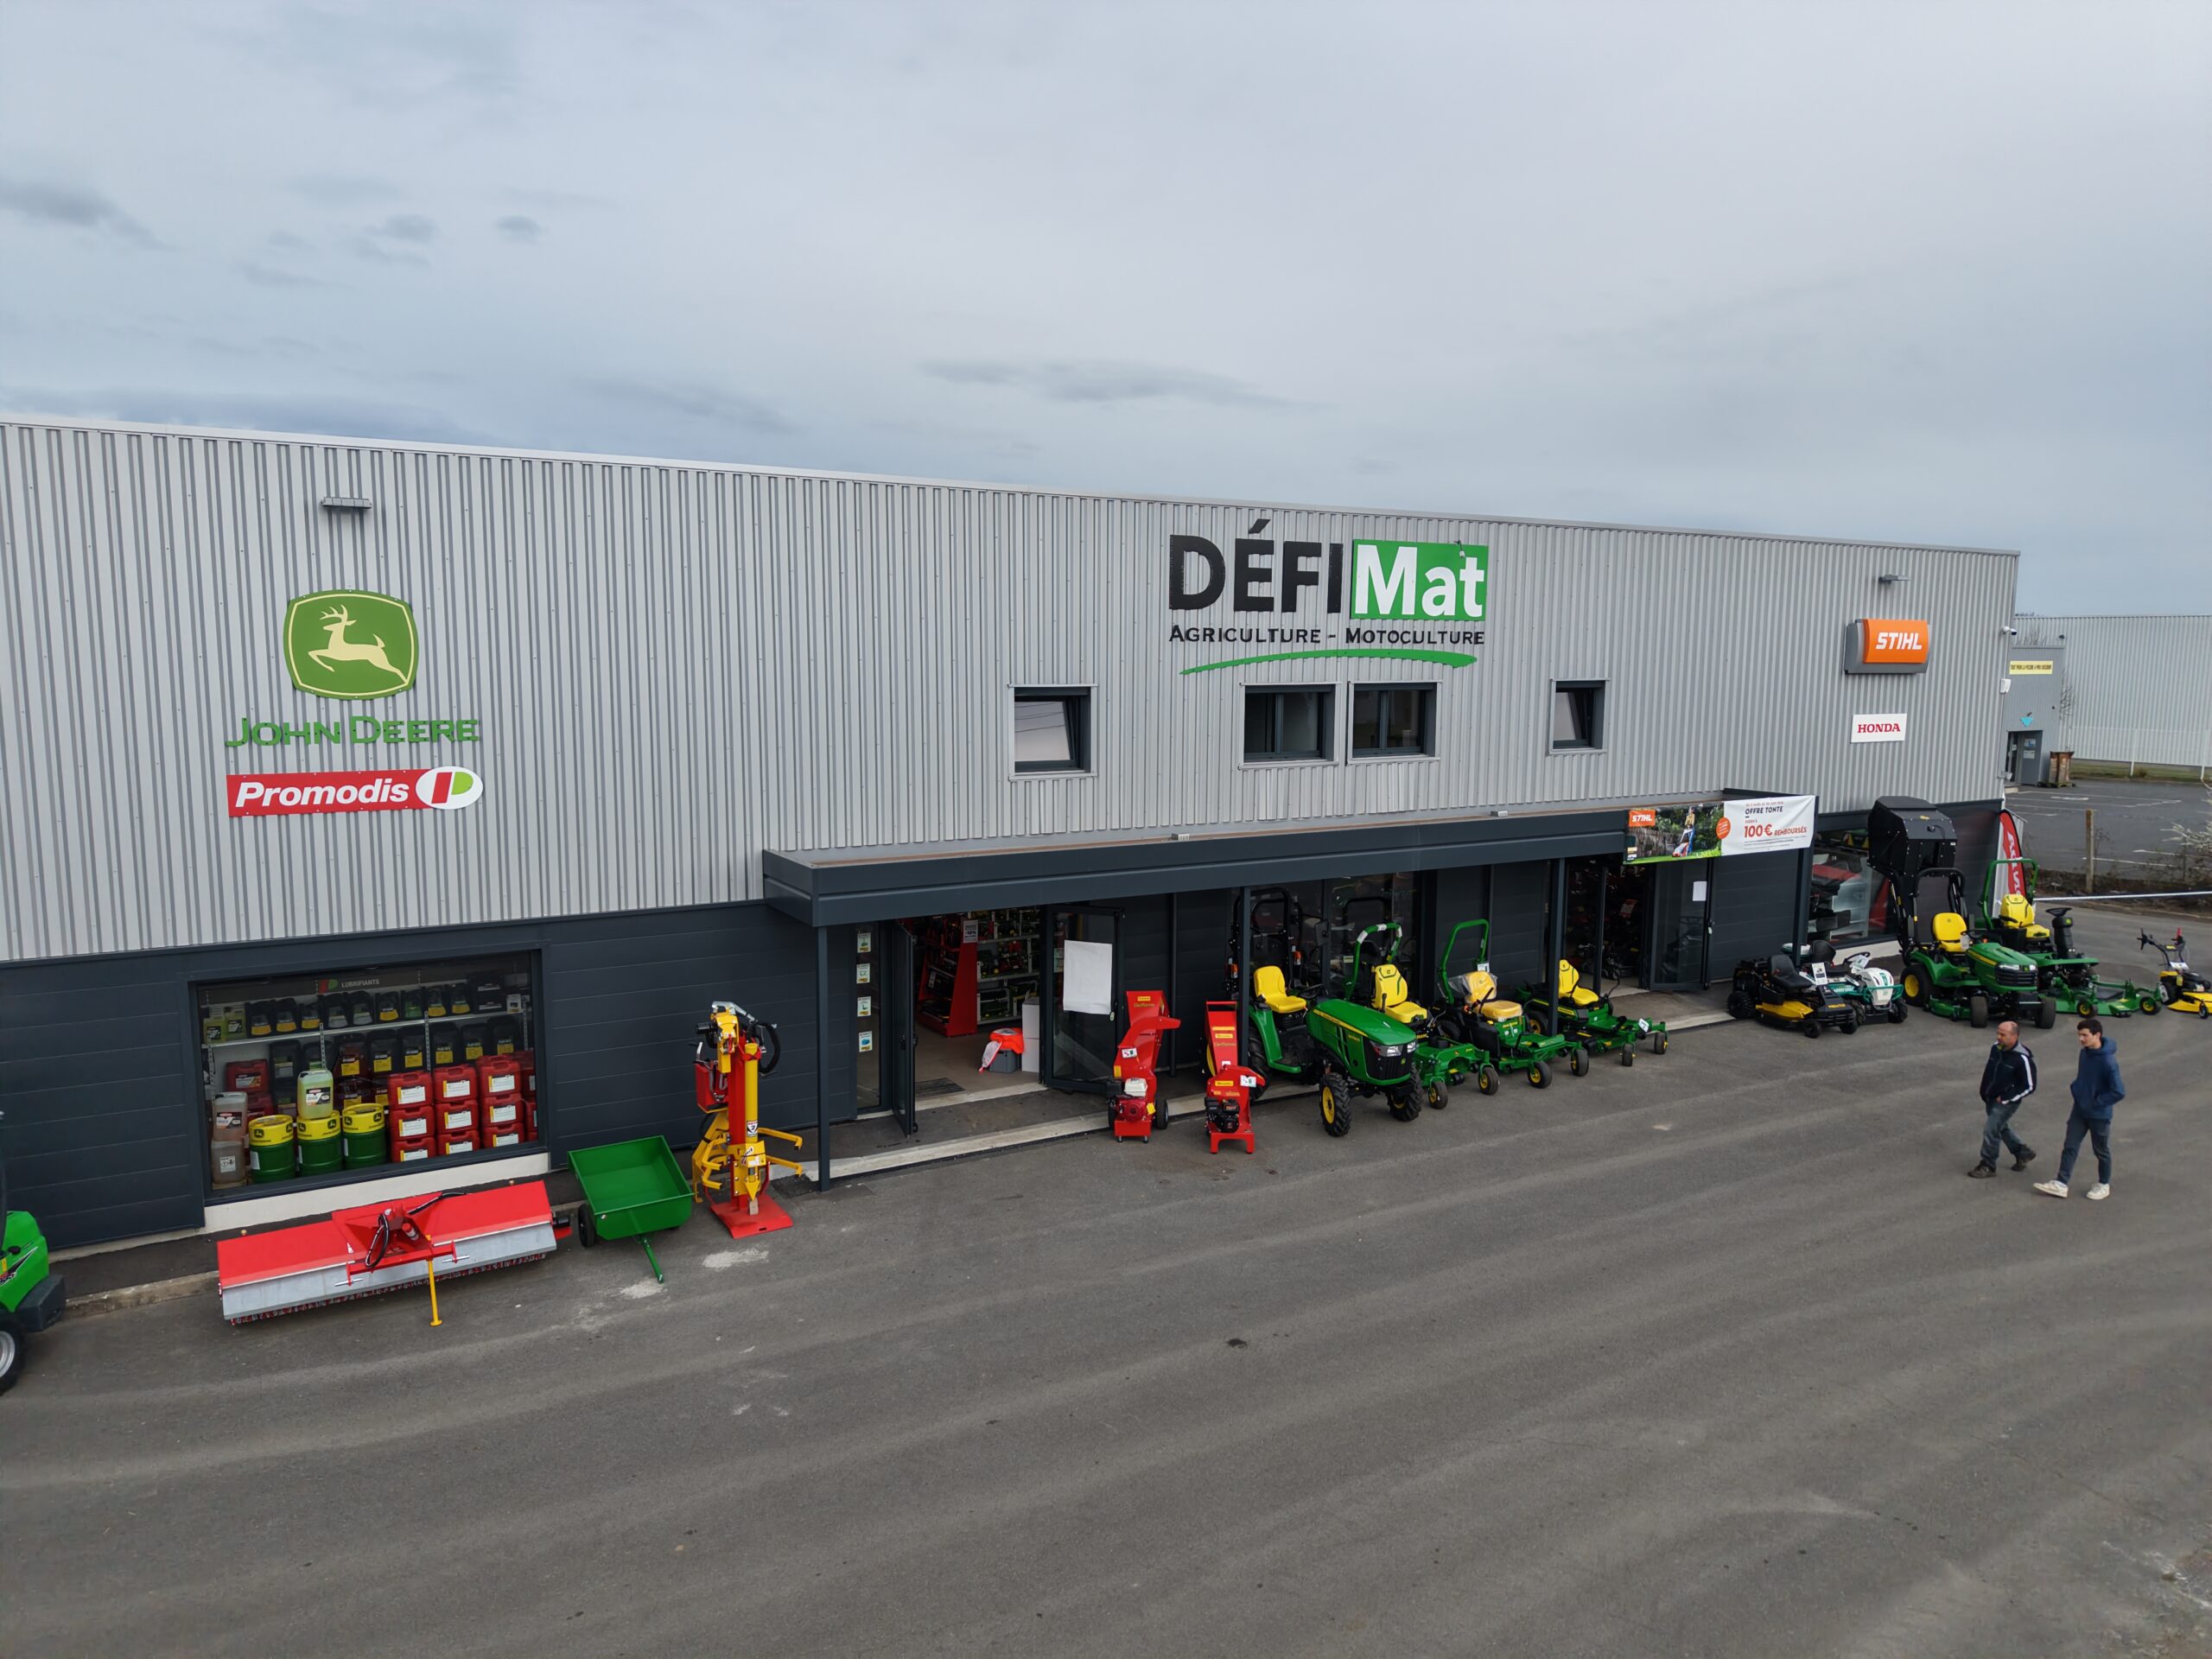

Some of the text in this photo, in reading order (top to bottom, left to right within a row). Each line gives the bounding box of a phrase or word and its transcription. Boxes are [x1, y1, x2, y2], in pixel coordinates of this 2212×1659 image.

[1169, 519, 1484, 617] DÉFI Mat
[1169, 625, 1321, 643] AGRICULTURE
[1345, 627, 1485, 645] MOTOCULTURE
[1876, 632, 1923, 650] STIHL
[225, 715, 480, 747] JOHN DEERE
[1857, 722, 1901, 734] HONDA
[235, 778, 410, 808] Promodis
[1631, 814, 1653, 823] STIHL
[341, 978, 380, 988] LUBRIFIANTS
